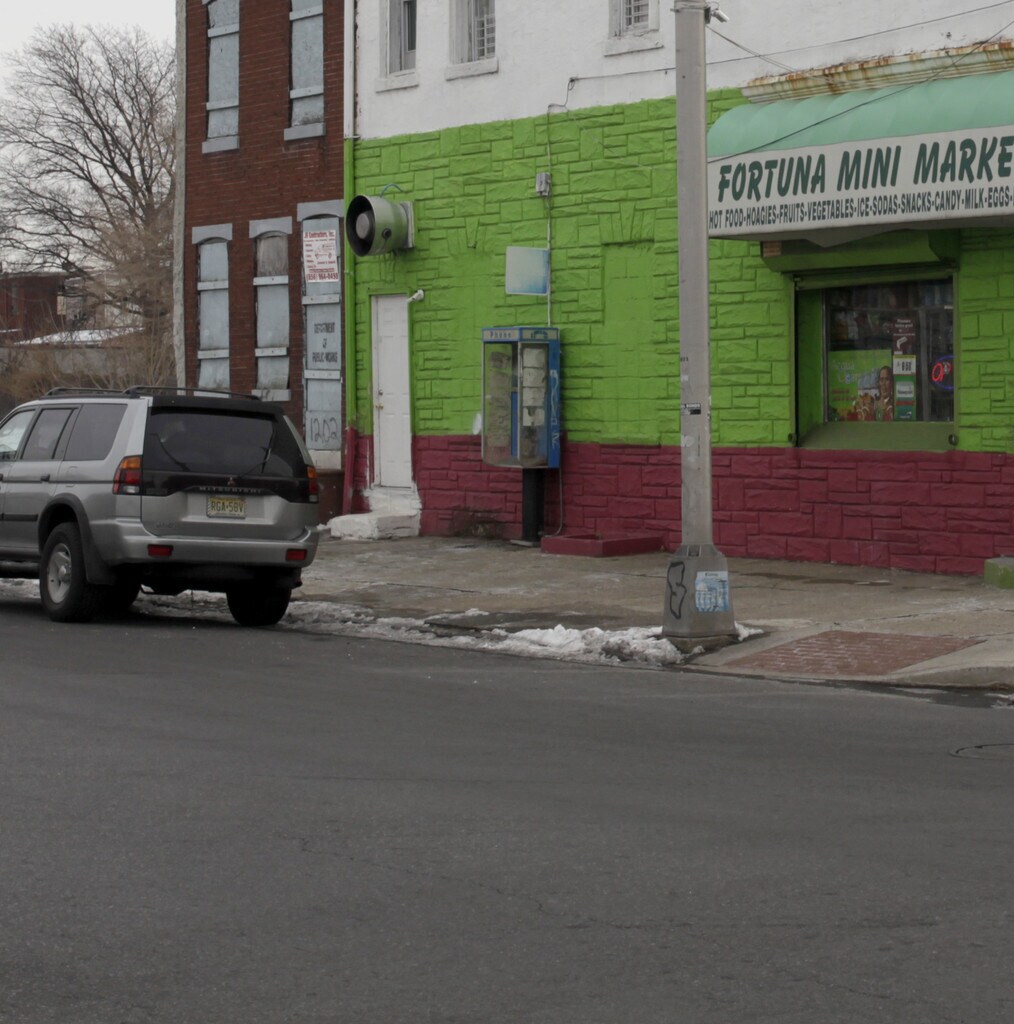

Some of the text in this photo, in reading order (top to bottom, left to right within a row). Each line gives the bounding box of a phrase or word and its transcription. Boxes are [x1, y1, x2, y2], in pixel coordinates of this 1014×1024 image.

[718, 154, 826, 203] FORTUNA
[837, 145, 902, 192] MINI
[709, 209, 723, 229] HOT
[310, 417, 338, 444] 1202
